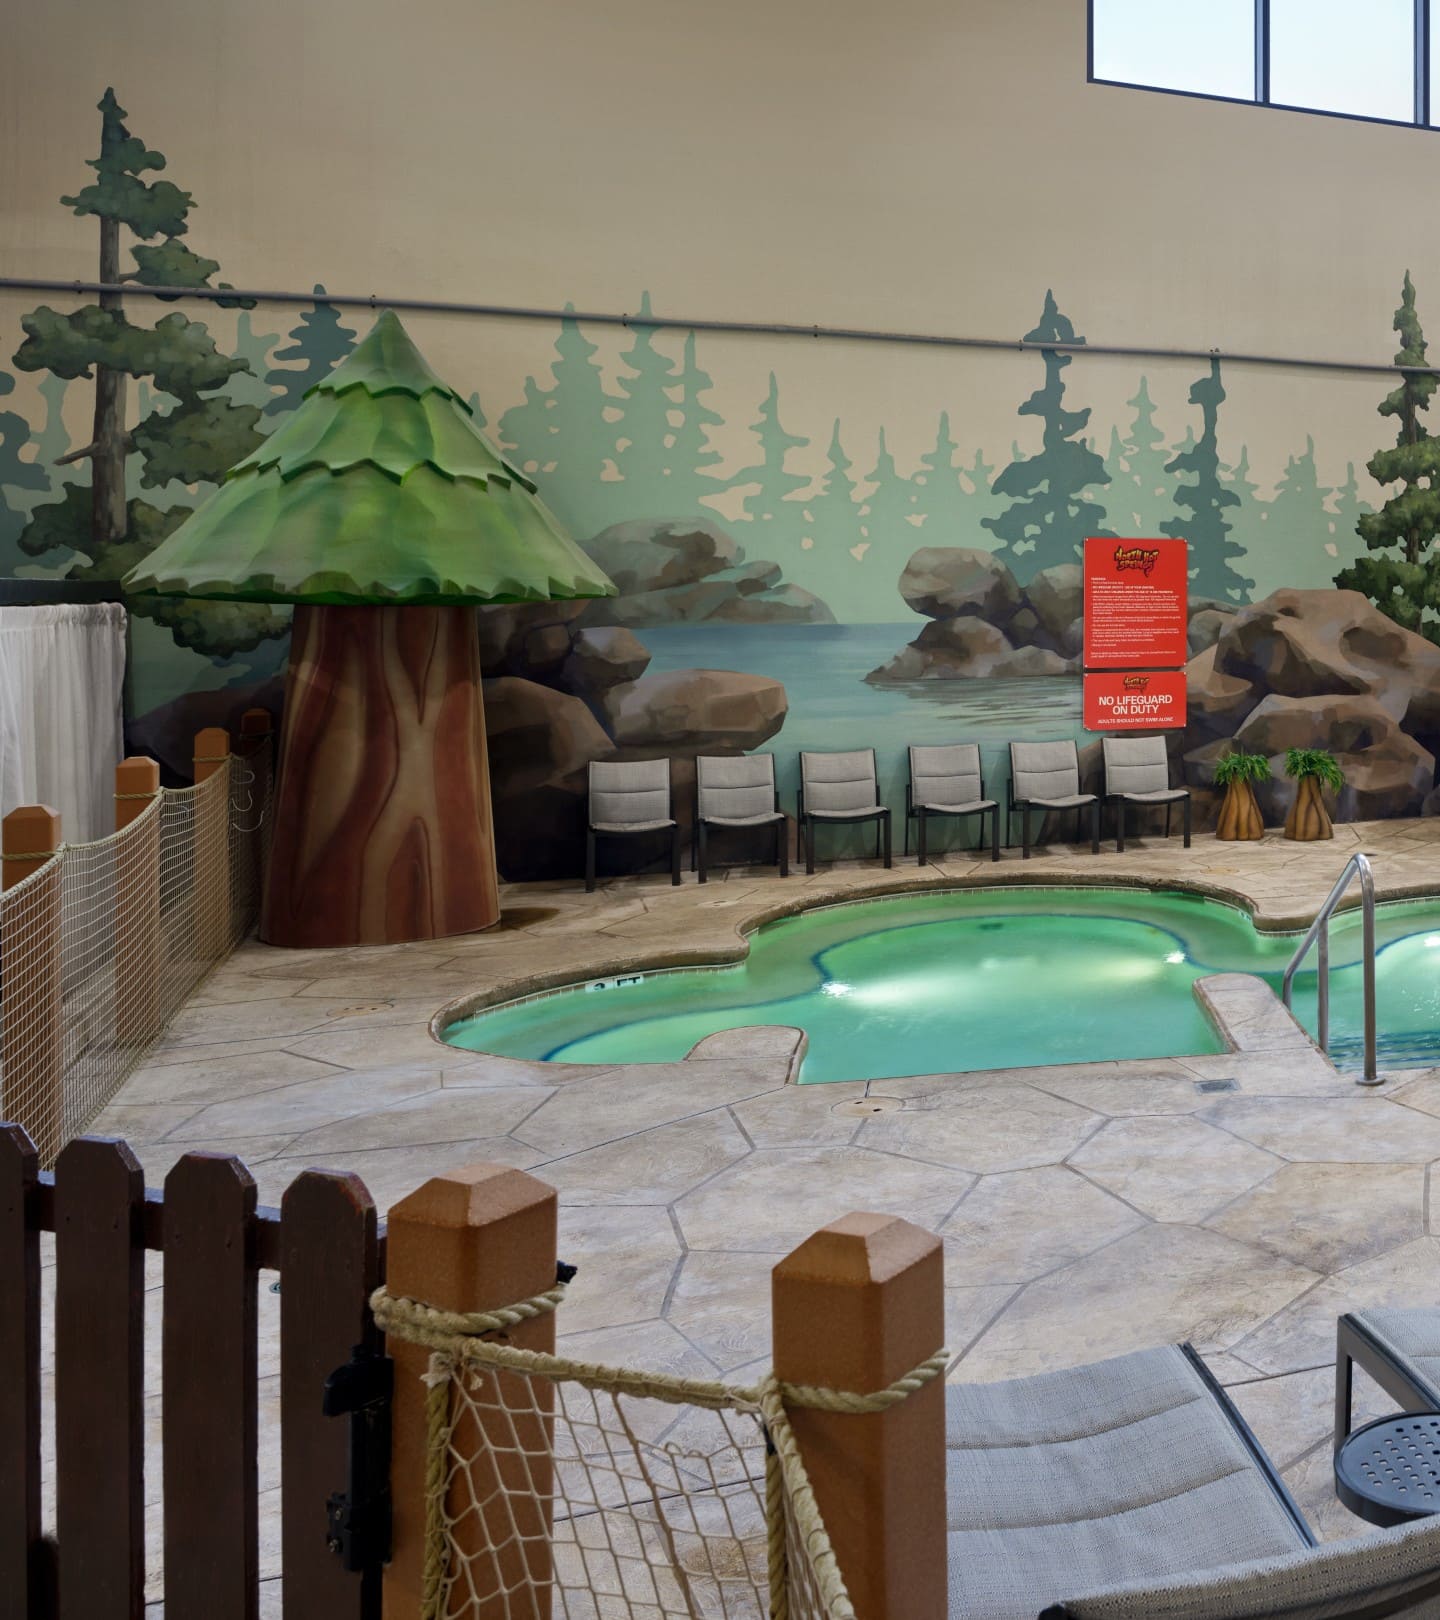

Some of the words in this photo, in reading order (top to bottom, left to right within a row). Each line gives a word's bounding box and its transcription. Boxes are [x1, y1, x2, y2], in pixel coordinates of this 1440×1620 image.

[1099, 696, 1114, 706] NO
[1117, 694, 1173, 705] LIFEGUARD
[1112, 705, 1128, 715] ON
[1130, 704, 1160, 714] DUTY
